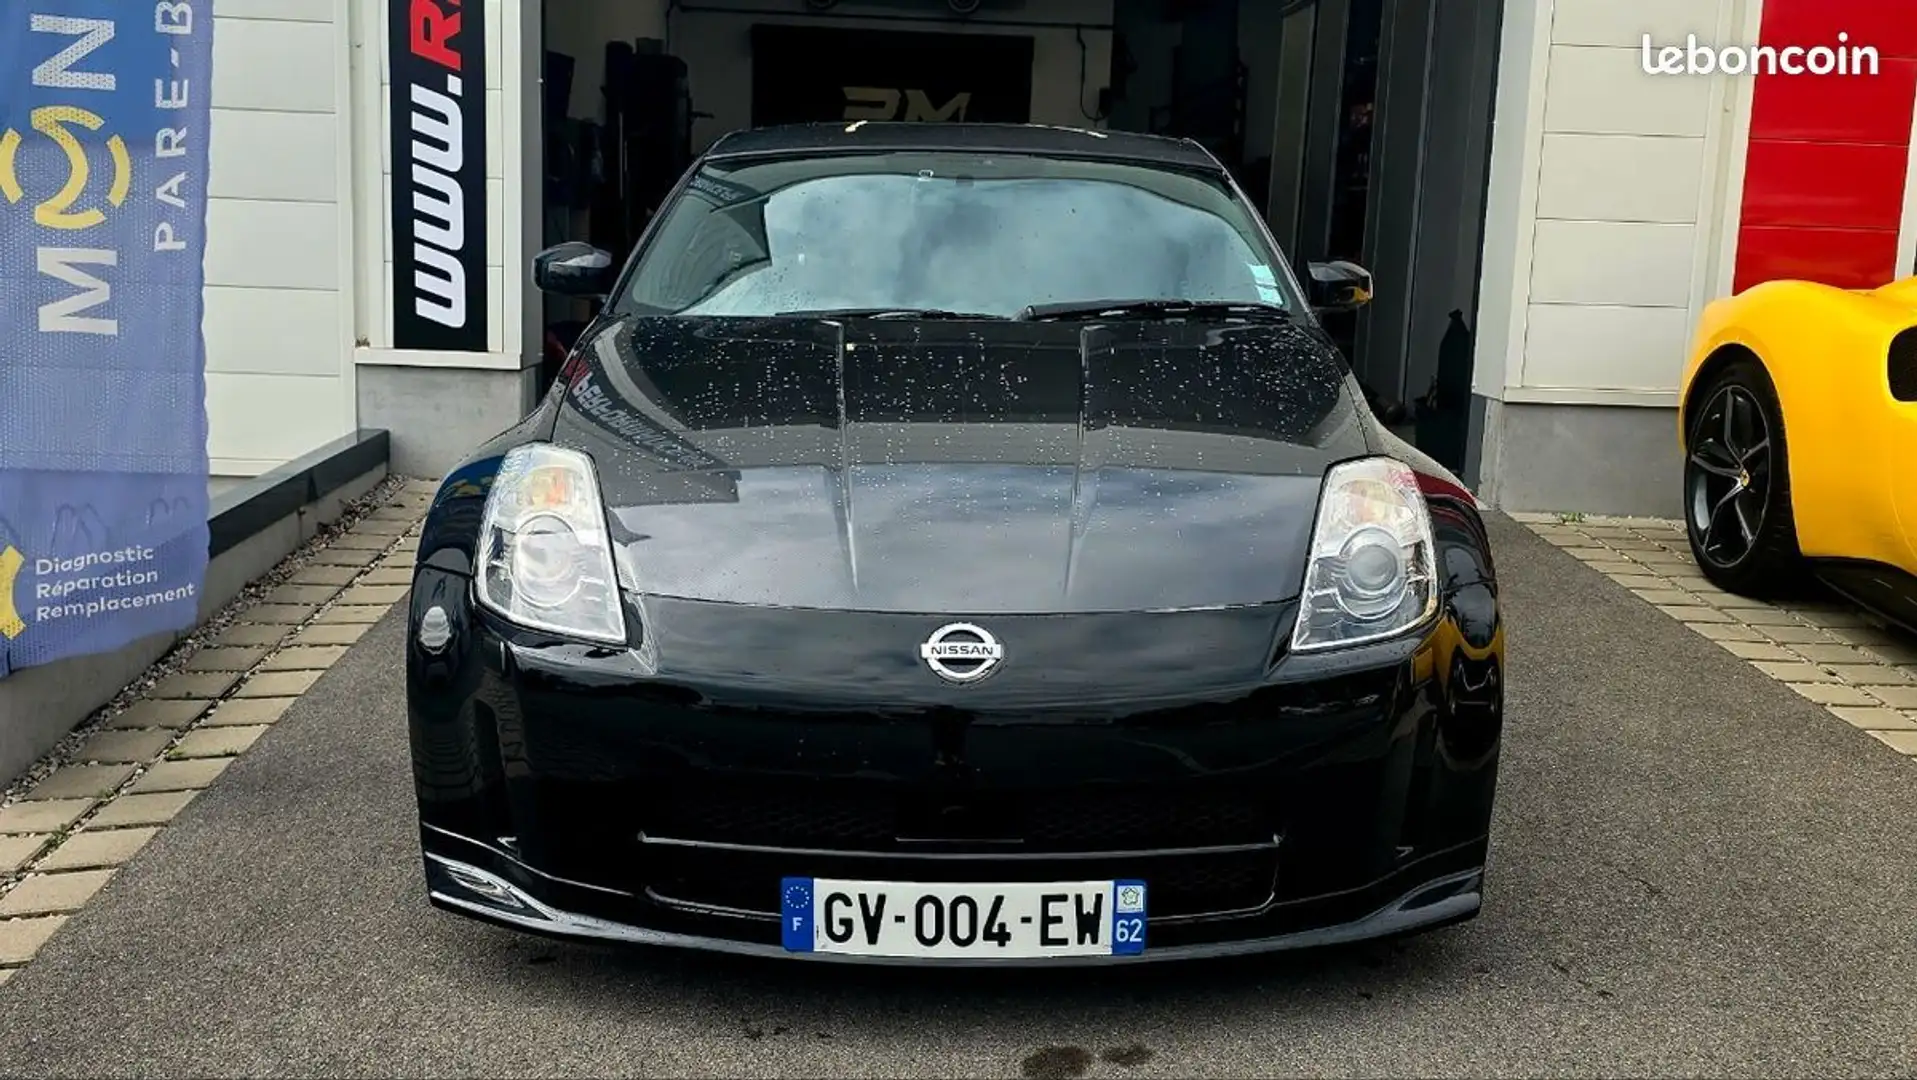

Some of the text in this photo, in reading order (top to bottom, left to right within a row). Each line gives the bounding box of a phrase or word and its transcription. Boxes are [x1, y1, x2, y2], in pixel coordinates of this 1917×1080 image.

[410, 0, 466, 329] www.R
[35, 544, 154, 576] Diagnostic
[36, 569, 158, 600] Réparation
[36, 582, 196, 622] Remplacement
[931, 645, 993, 656] NISSAN
[792, 917, 804, 931] F
[823, 892, 1104, 948] GV-004-EW
[1116, 918, 1143, 943] 62
